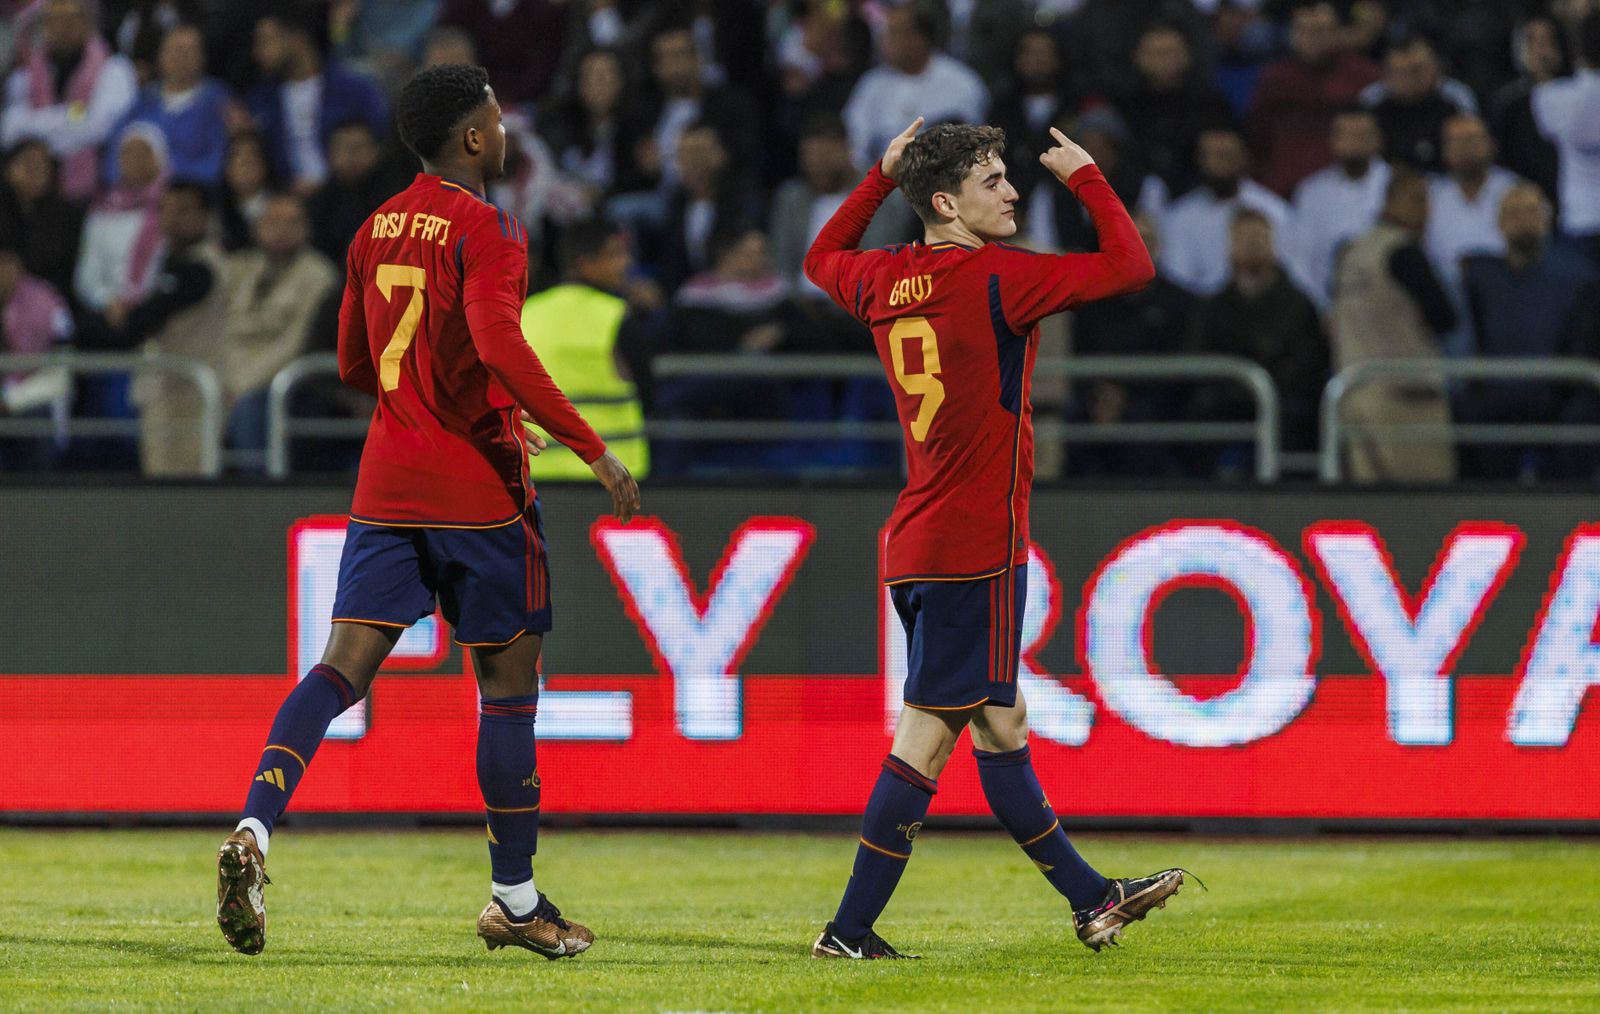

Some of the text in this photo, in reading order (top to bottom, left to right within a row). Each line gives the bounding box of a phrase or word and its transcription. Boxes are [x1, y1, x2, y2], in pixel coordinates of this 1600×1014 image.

[410, 212, 452, 246] FATI
[375, 264, 427, 393] 7
[889, 273, 933, 306] GAVI
[888, 316, 946, 442] 9
